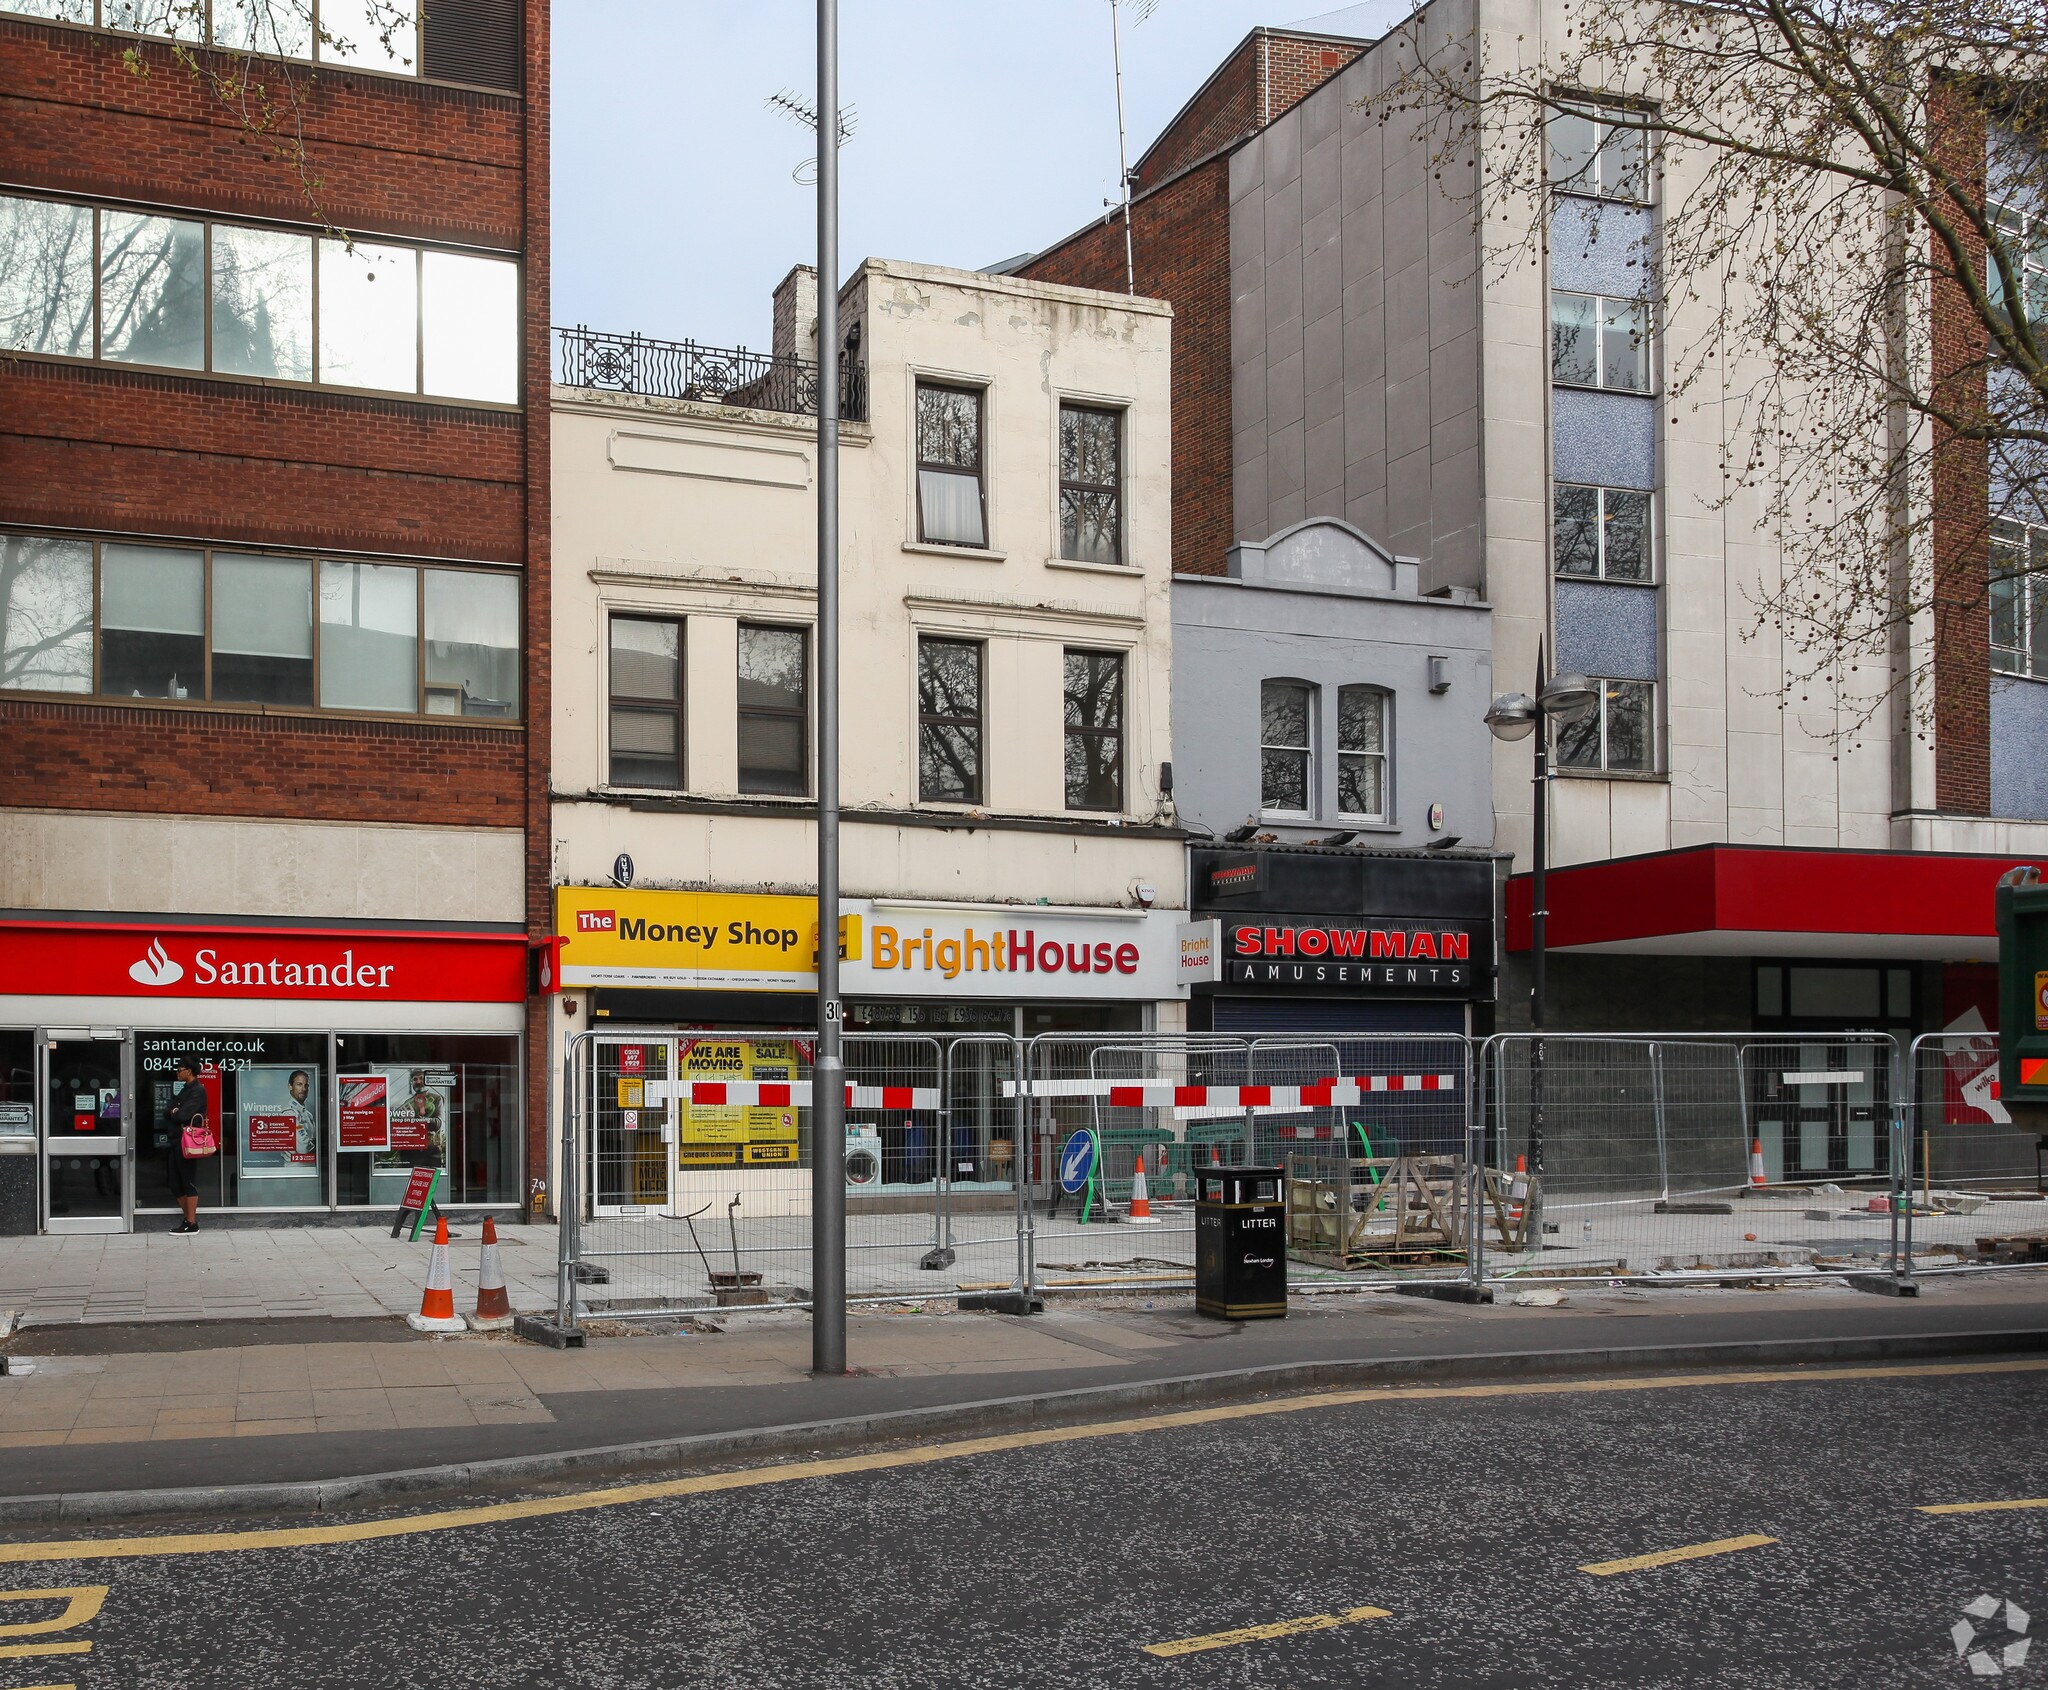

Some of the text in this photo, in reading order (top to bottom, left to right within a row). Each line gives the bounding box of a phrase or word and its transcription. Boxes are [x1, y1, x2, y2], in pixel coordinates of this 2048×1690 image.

[1211, 865, 1256, 881] SHOWMAN
[1212, 874, 1254, 886] AMUSEMENTS
[579, 913, 612, 930] The
[619, 918, 799, 952] Money Shop
[1181, 937, 1210, 954] Bright
[1235, 927, 1469, 960] SHOWMAN
[871, 925, 1140, 979] BrightHouse
[1181, 953, 1210, 968] House
[194, 949, 394, 989] Santander
[1244, 965, 1460, 983] AMUSEMENTS
[143, 1037, 265, 1052] santander.co.uk
[691, 1046, 740, 1059] WE ARE
[218, 1058, 252, 1072] 4321
[687, 1058, 744, 1070] MOVING
[1974, 1073, 1996, 1093] wilko
[243, 1102, 282, 1112] Winners
[531, 1178, 546, 1194] 70
[1201, 1216, 1221, 1227] LITTER
[1241, 1218, 1276, 1229] LITTER
